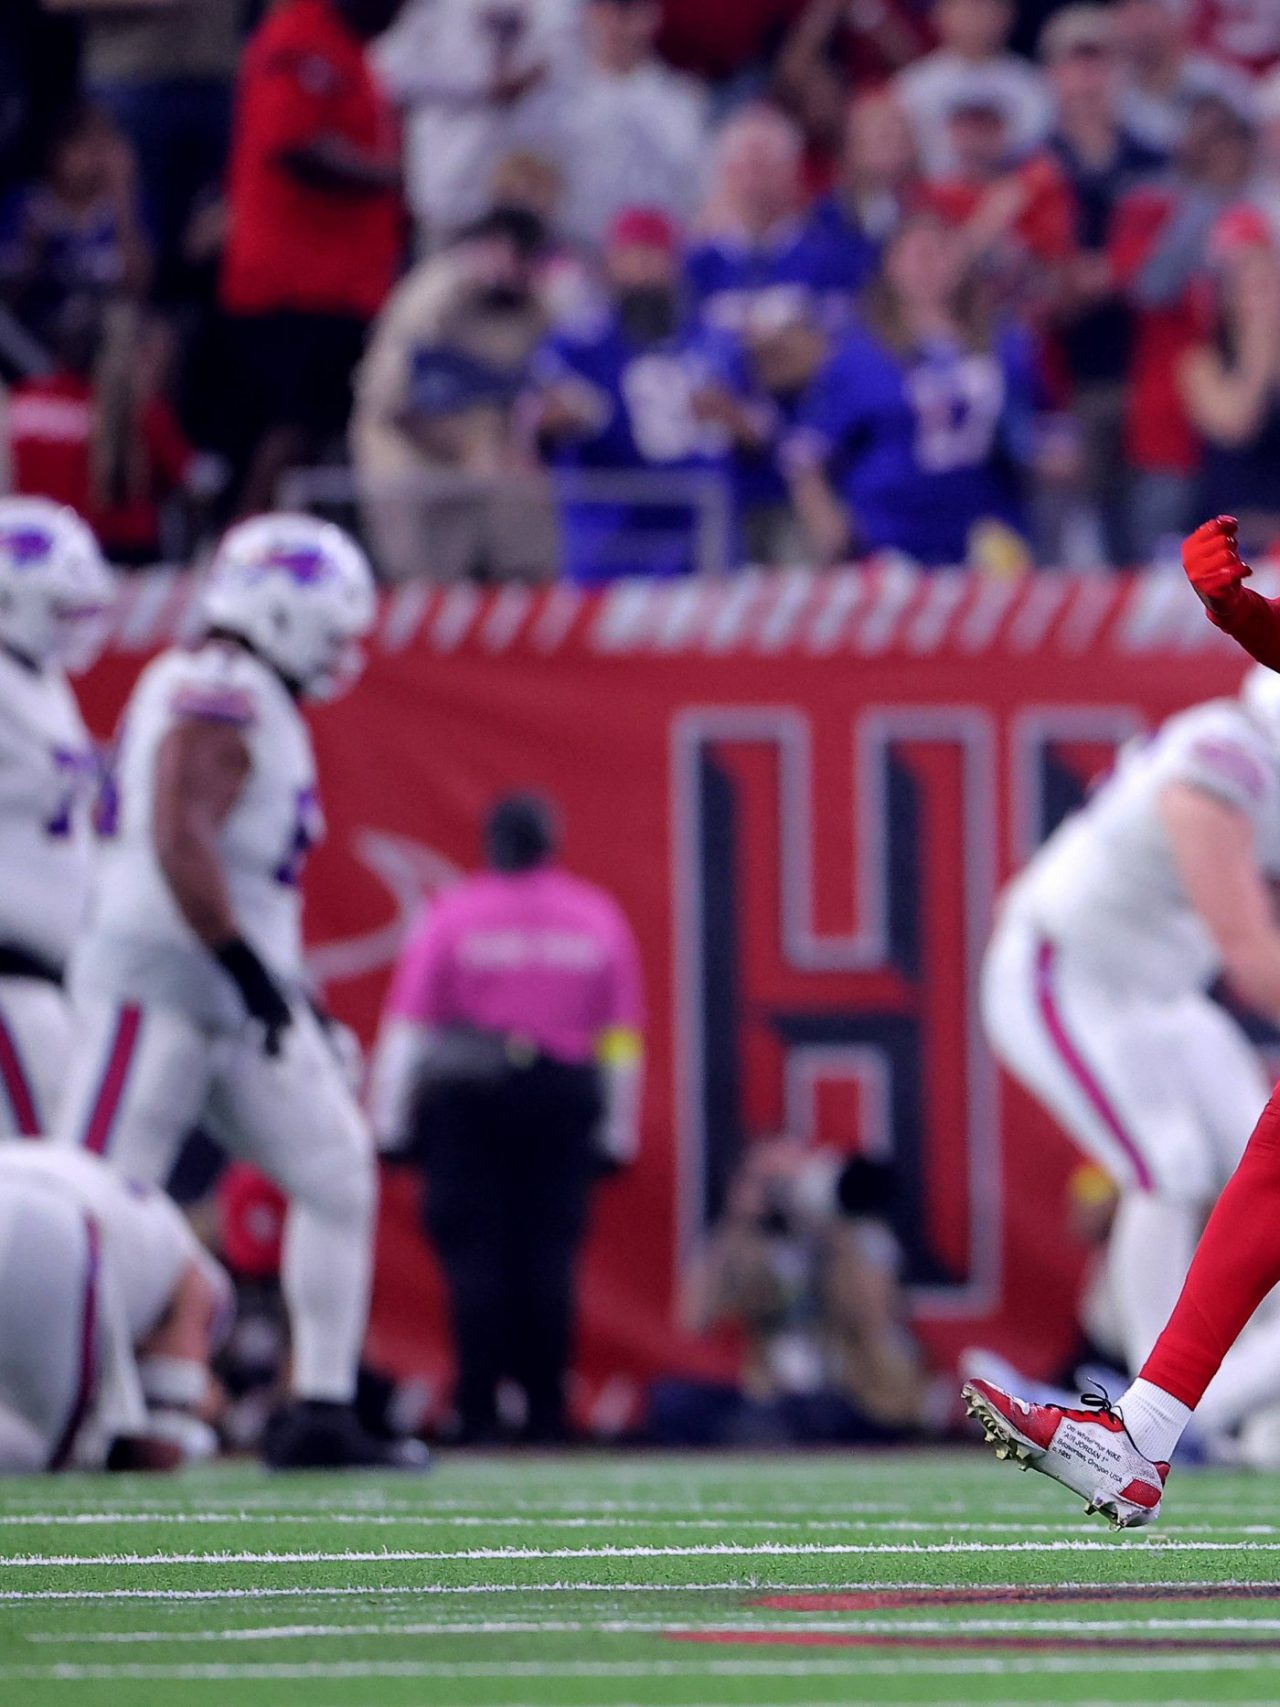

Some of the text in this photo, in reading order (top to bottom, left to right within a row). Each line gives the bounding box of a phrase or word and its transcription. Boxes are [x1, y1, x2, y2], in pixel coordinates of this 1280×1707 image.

[1075, 1440, 1101, 1459] JORDAN
[1106, 1449, 1122, 1462] NIKE
[1087, 1458, 1109, 1476] Oregon
[1109, 1471, 1123, 1483] USA
